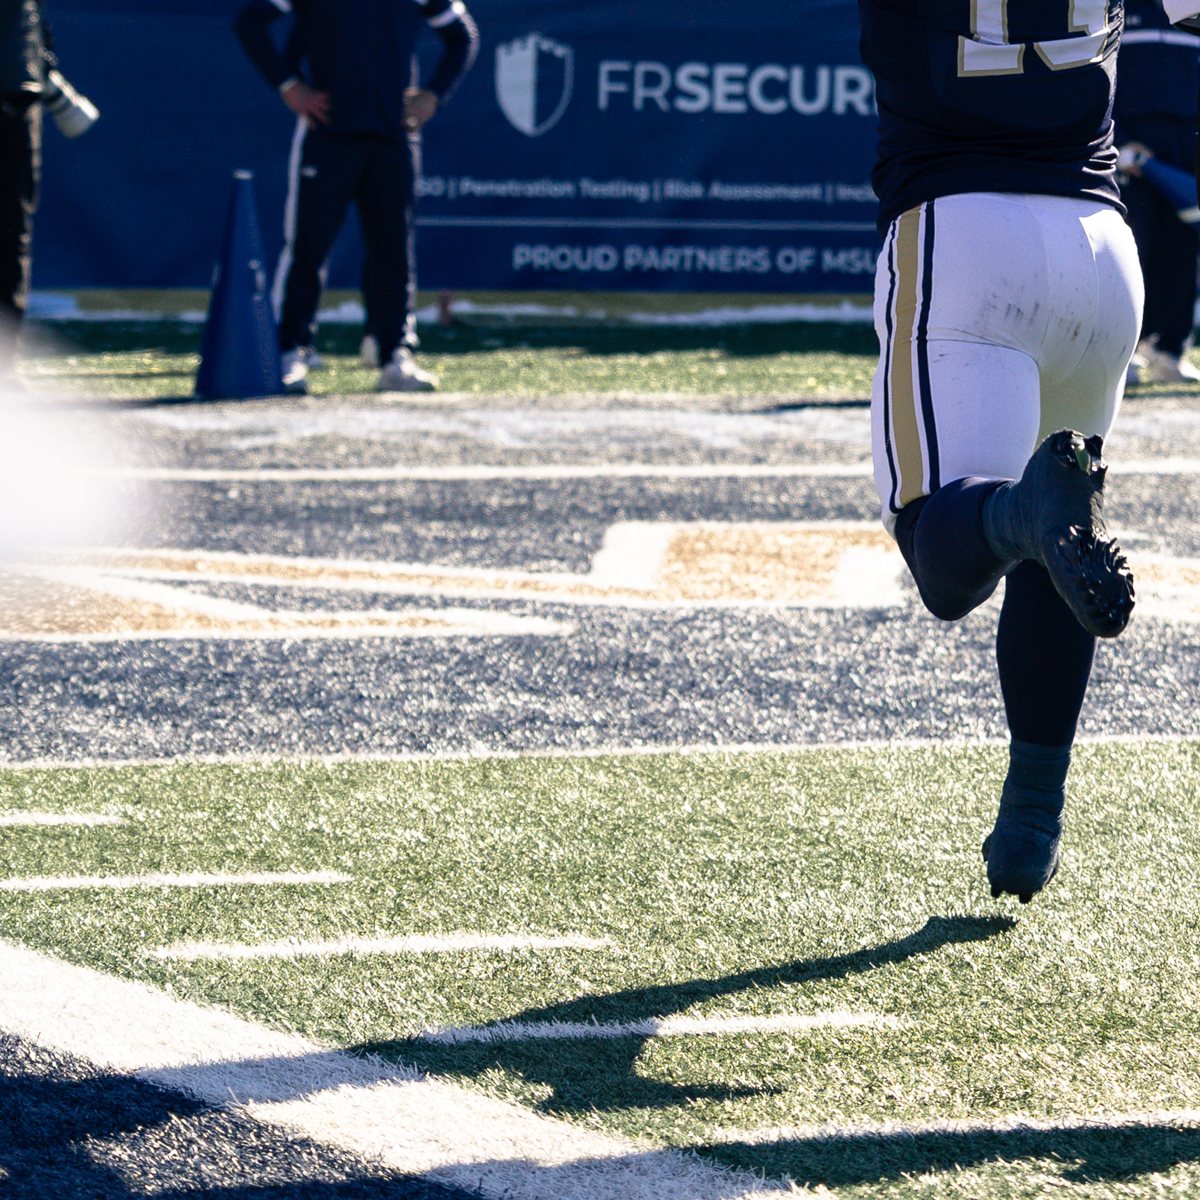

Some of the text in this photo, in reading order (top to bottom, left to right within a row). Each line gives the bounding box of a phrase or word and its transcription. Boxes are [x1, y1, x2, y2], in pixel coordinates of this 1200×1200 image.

[598, 59, 877, 116] FRSECUR
[512, 243, 619, 272] PROUD
[623, 245, 771, 274] PARTNERS
[776, 247, 816, 274] OF
